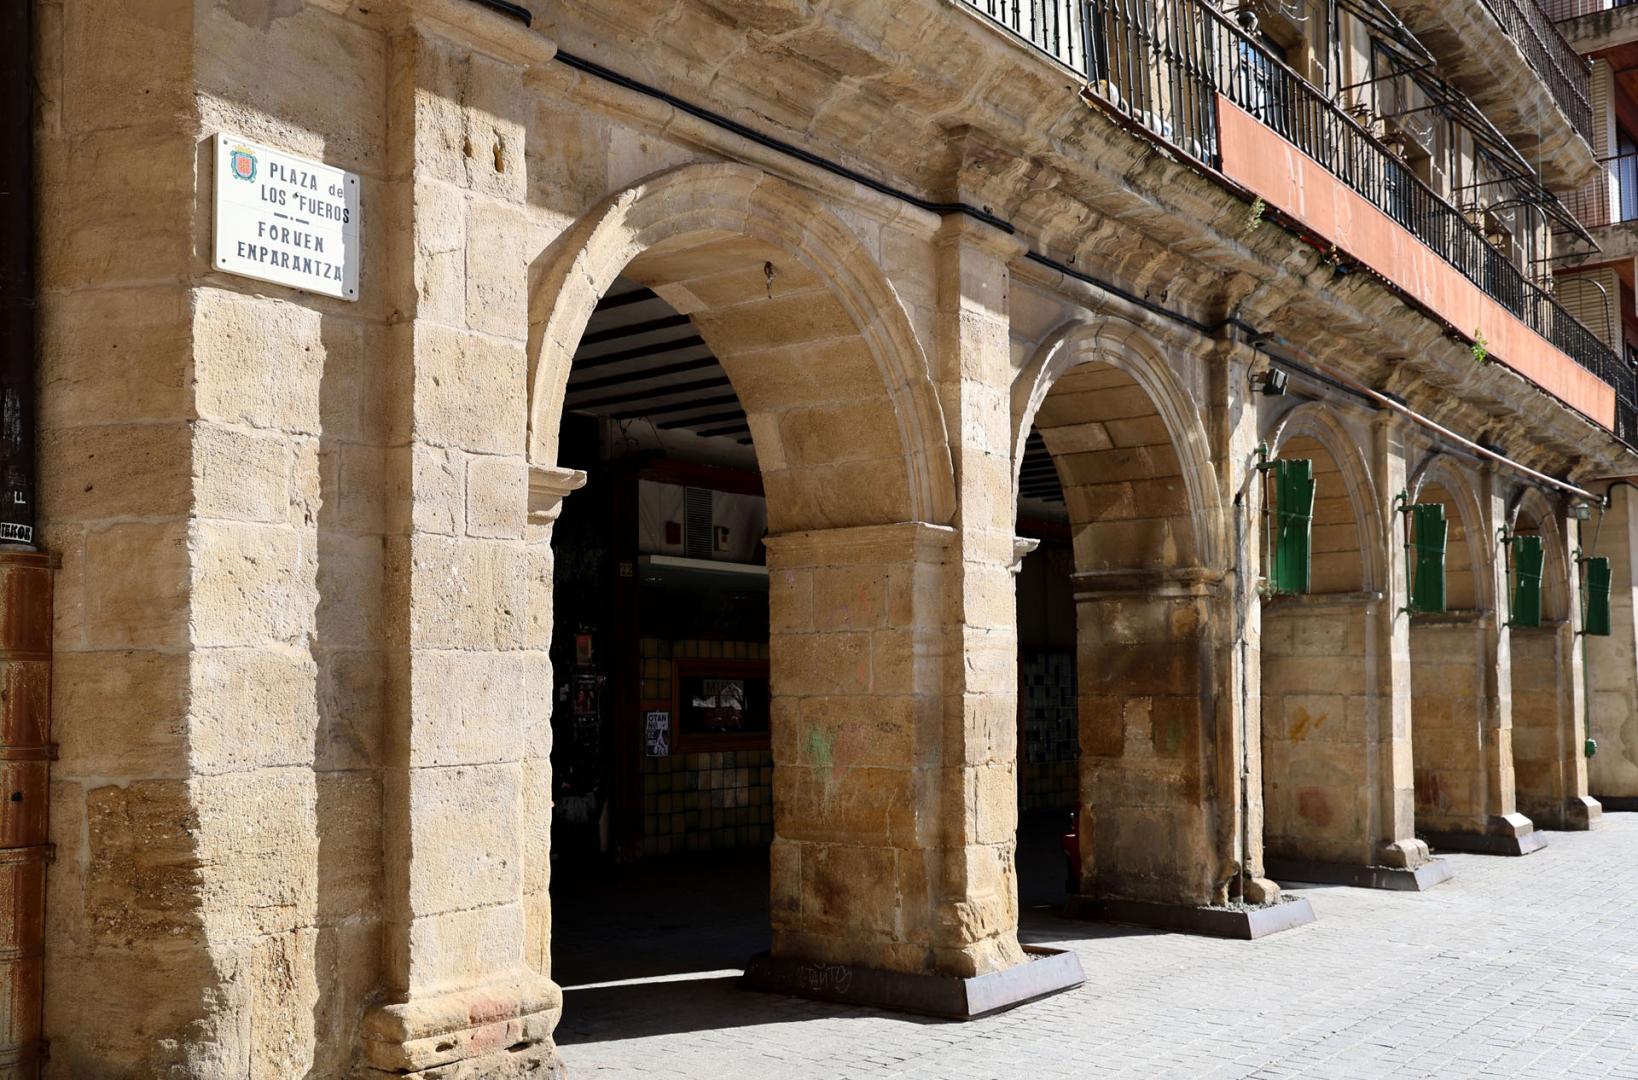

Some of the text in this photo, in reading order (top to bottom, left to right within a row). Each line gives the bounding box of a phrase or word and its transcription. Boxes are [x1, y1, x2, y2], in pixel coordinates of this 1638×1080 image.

[269, 162, 344, 198] PLAZA de
[261, 184, 350, 224] LOS FUEROS
[257, 221, 324, 253] FORUEN
[237, 240, 342, 282] ENPARANTZA
[648, 714, 667, 722] OTAN
